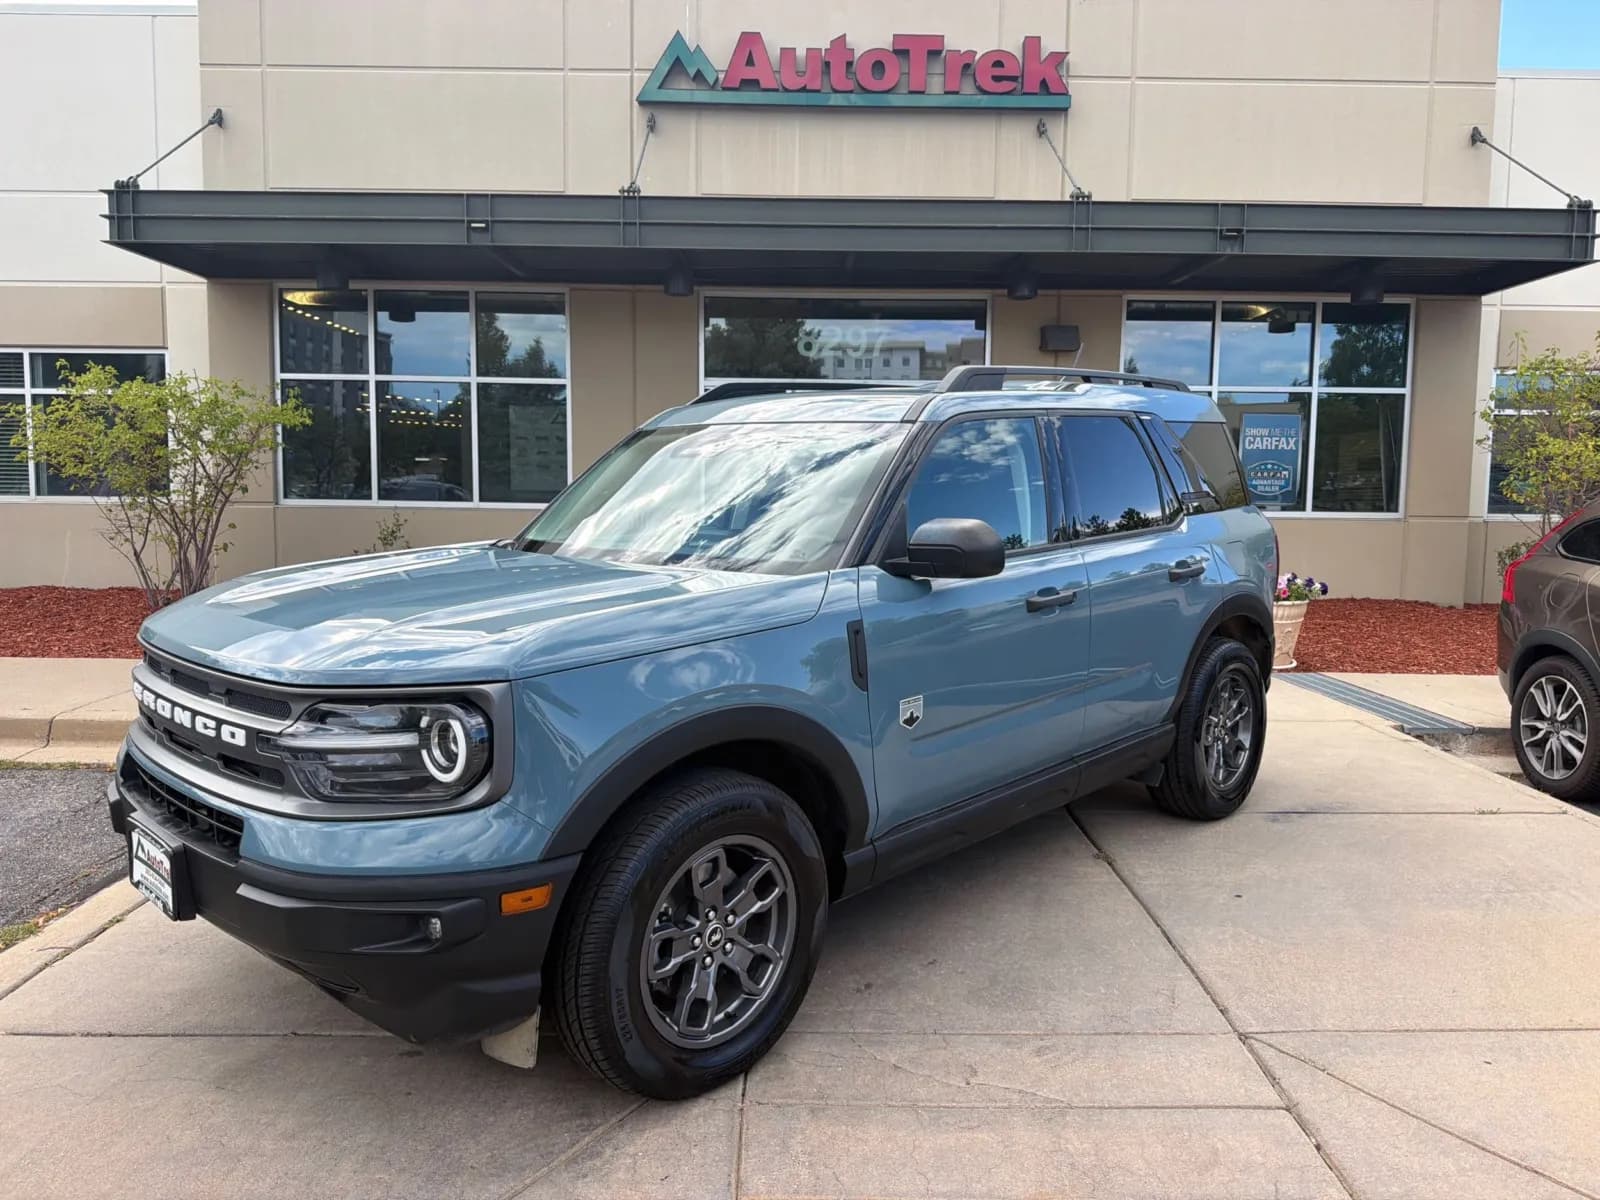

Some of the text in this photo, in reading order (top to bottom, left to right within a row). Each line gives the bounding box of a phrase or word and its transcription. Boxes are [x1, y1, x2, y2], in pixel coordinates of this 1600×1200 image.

[721, 31, 1070, 95] AutoTrek
[797, 325, 888, 358] 8297
[1245, 427, 1269, 436] SHOW
[1245, 437, 1296, 450] CARFAX
